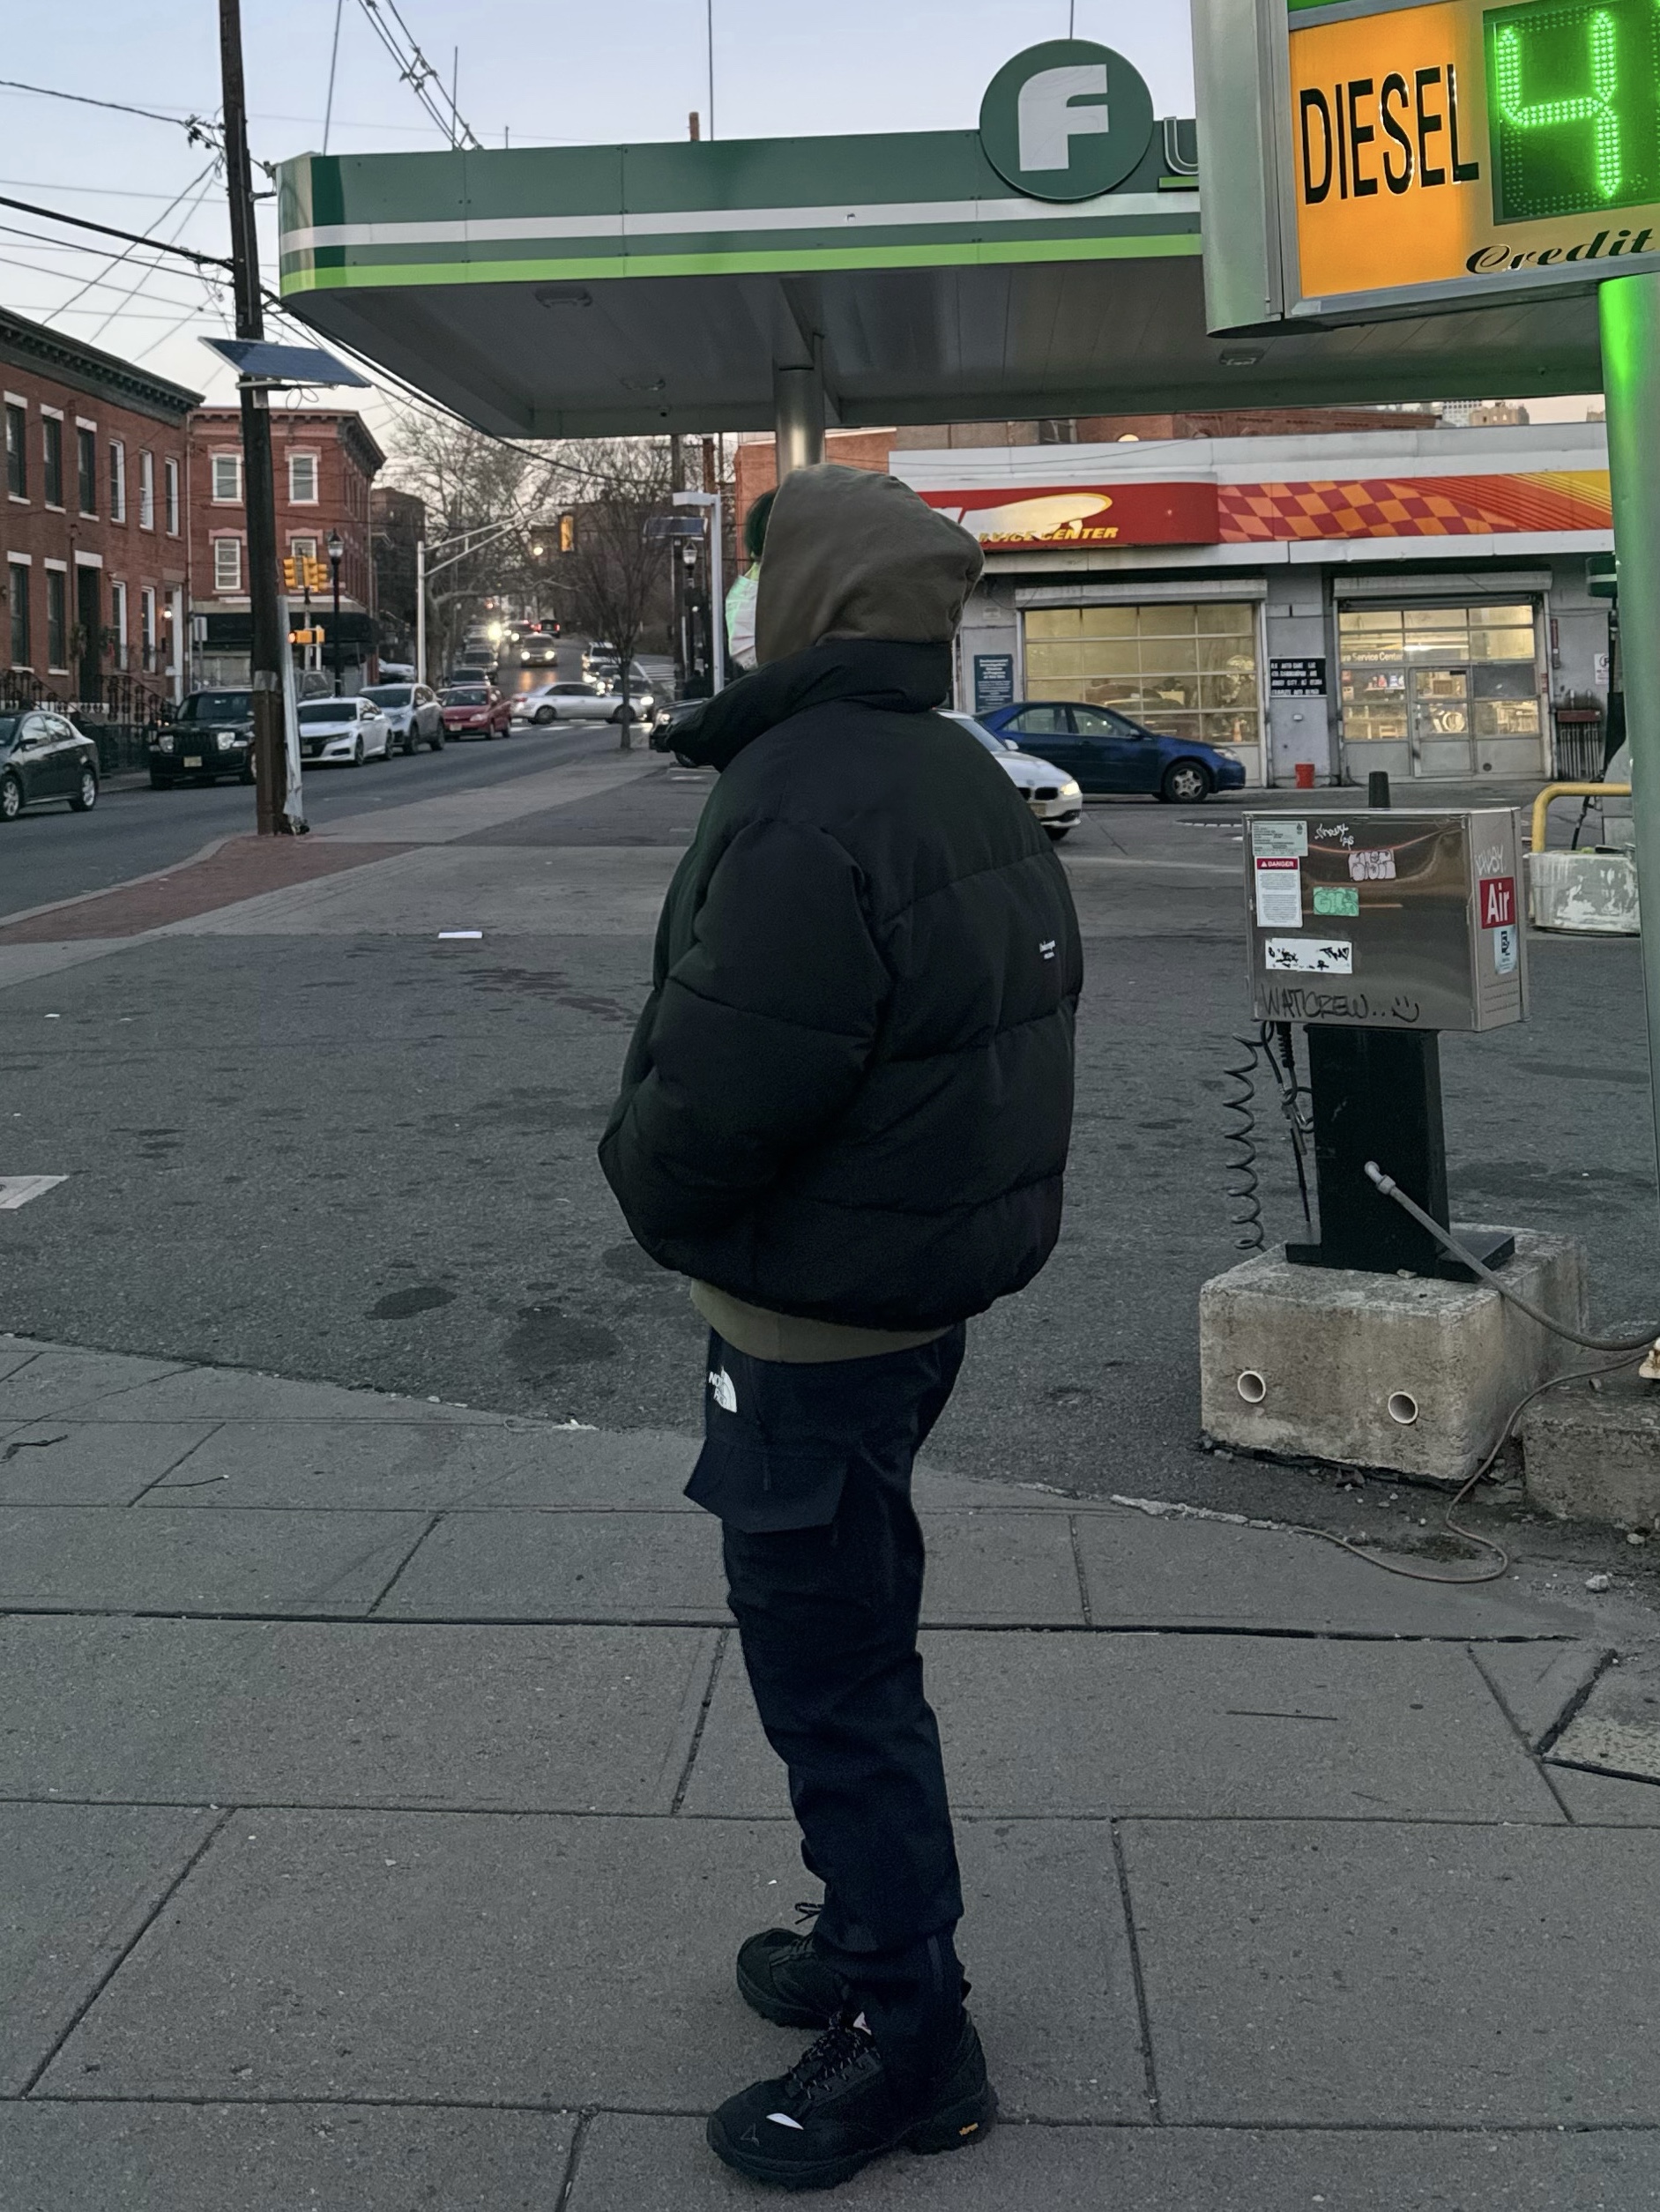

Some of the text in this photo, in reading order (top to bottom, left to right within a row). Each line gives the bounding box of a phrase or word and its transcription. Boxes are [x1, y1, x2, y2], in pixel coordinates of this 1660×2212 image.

[1498, 11, 1620, 199] 4
[1300, 63, 1479, 205] DIESEL
[1466, 228, 1656, 274] Credit
[1041, 527, 1119, 541] CENTER
[1352, 652, 1378, 661] Service
[1379, 652, 1403, 661] Center
[1486, 883, 1510, 925] Air
